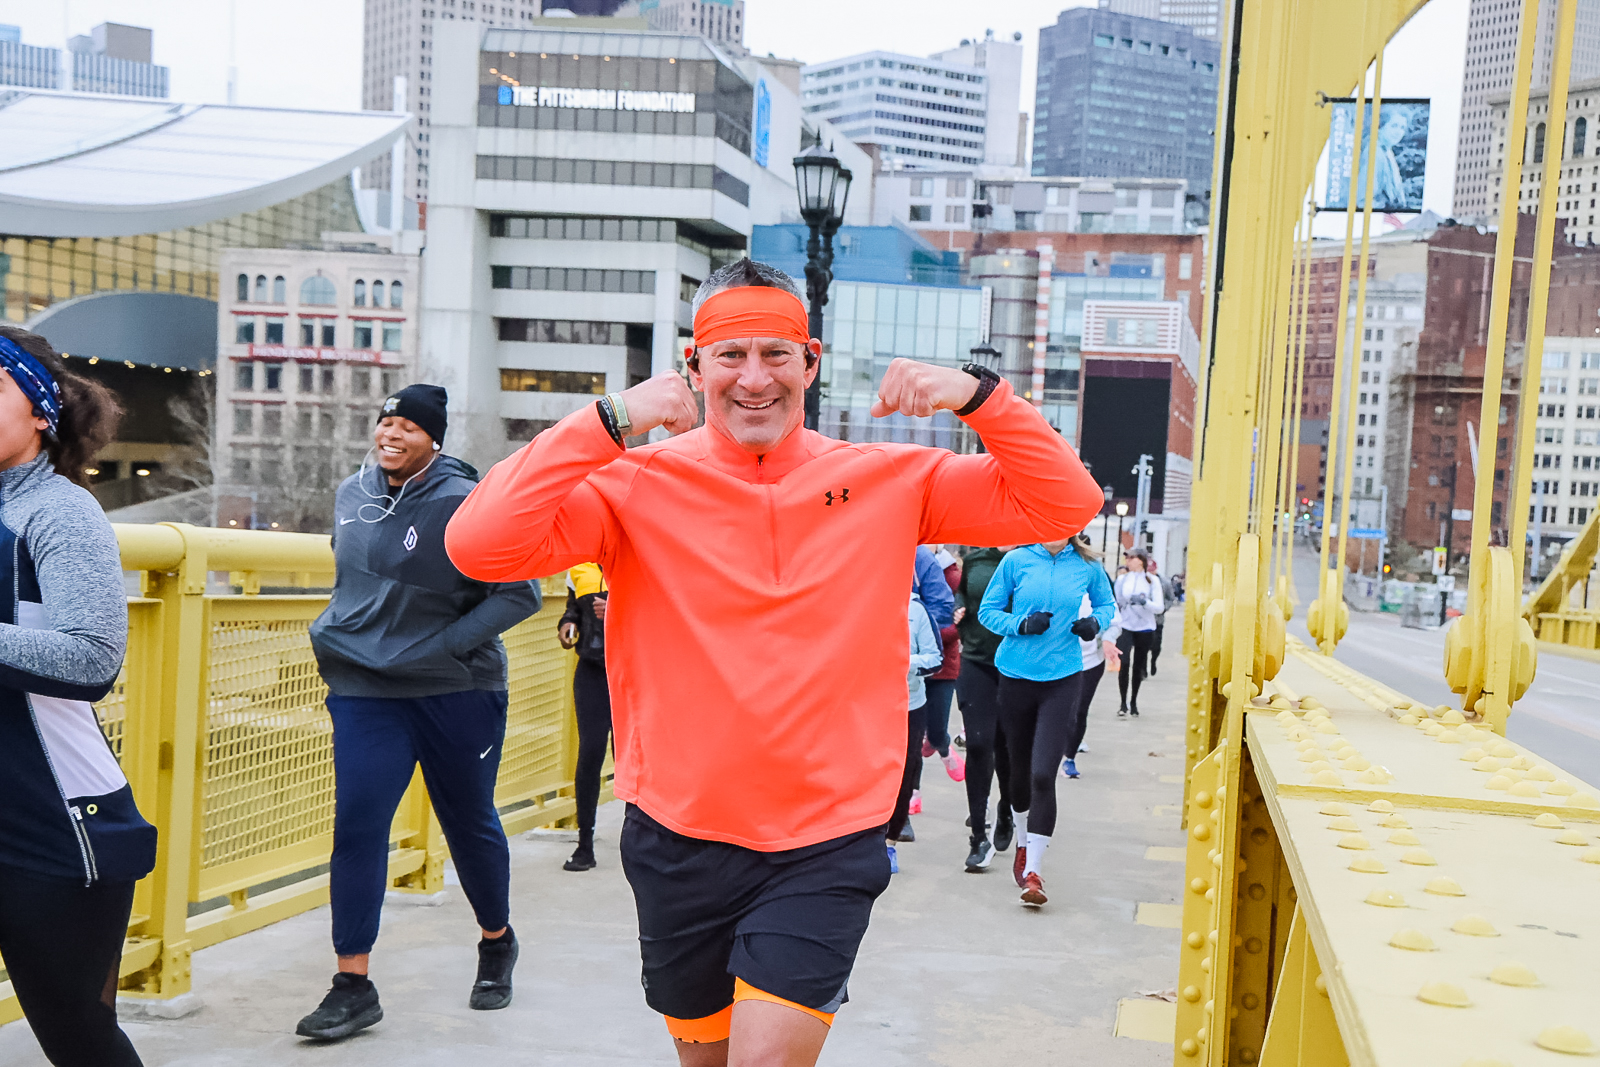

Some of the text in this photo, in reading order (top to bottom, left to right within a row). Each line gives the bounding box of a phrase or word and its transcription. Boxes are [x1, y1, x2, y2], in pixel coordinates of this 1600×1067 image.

[512, 86, 695, 112] THE PITTSBURGH FOUNDATION
